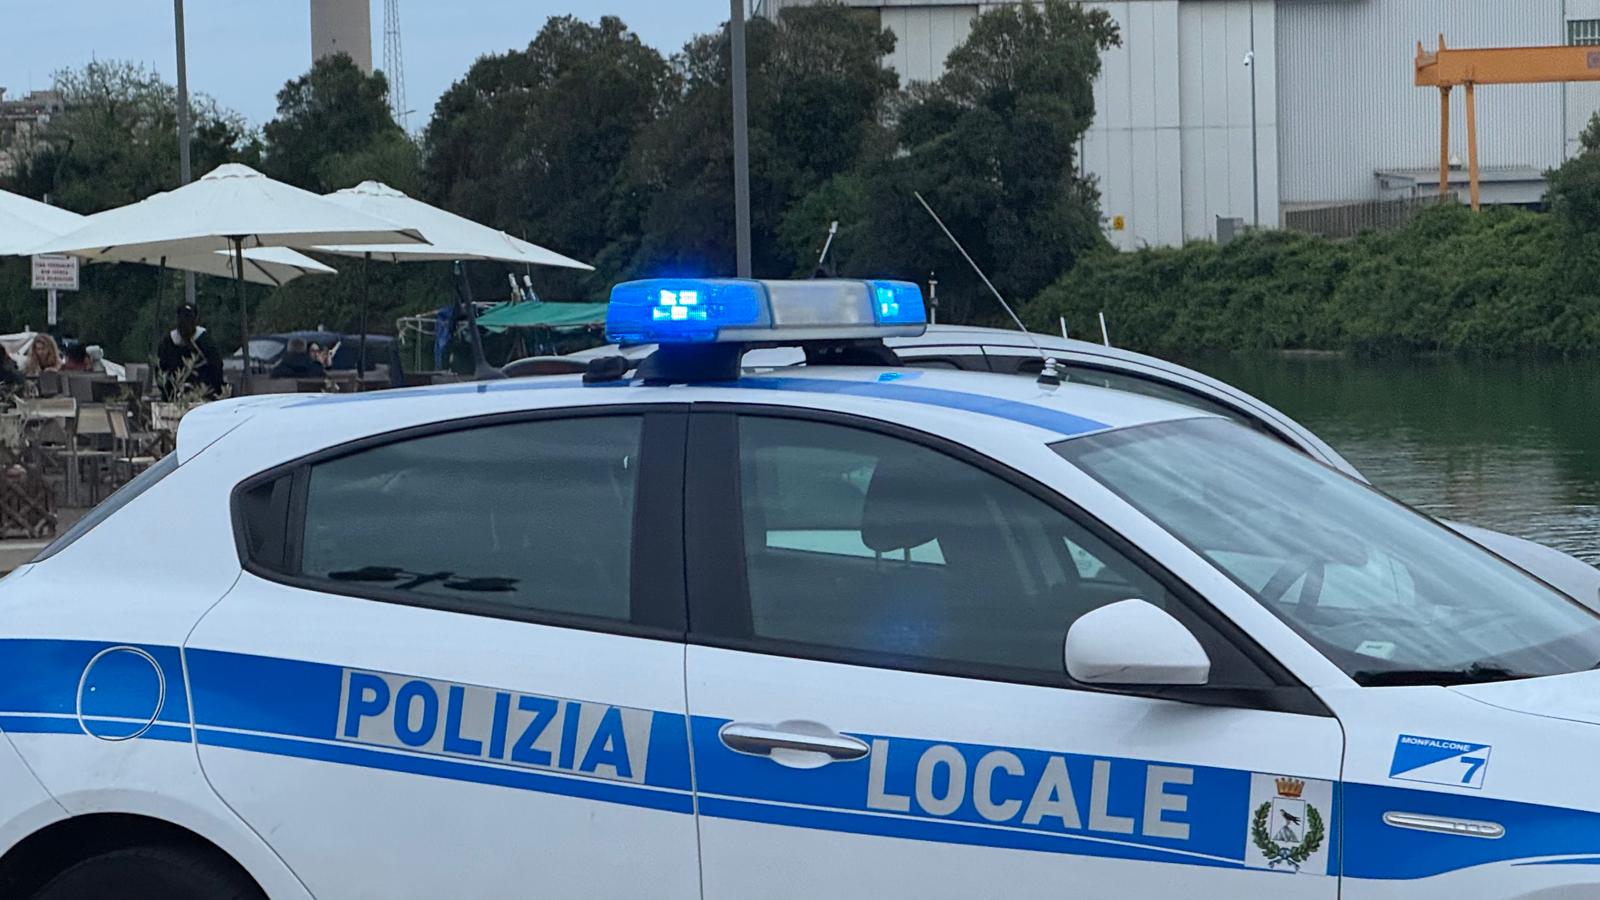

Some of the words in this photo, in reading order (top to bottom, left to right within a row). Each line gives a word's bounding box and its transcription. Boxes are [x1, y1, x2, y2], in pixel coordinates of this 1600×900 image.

[344, 672, 633, 778] POLIZIA
[866, 738, 1194, 840] LOCALE
[1401, 737, 1471, 752] MONFALCONE
[1460, 756, 1485, 784] 7
